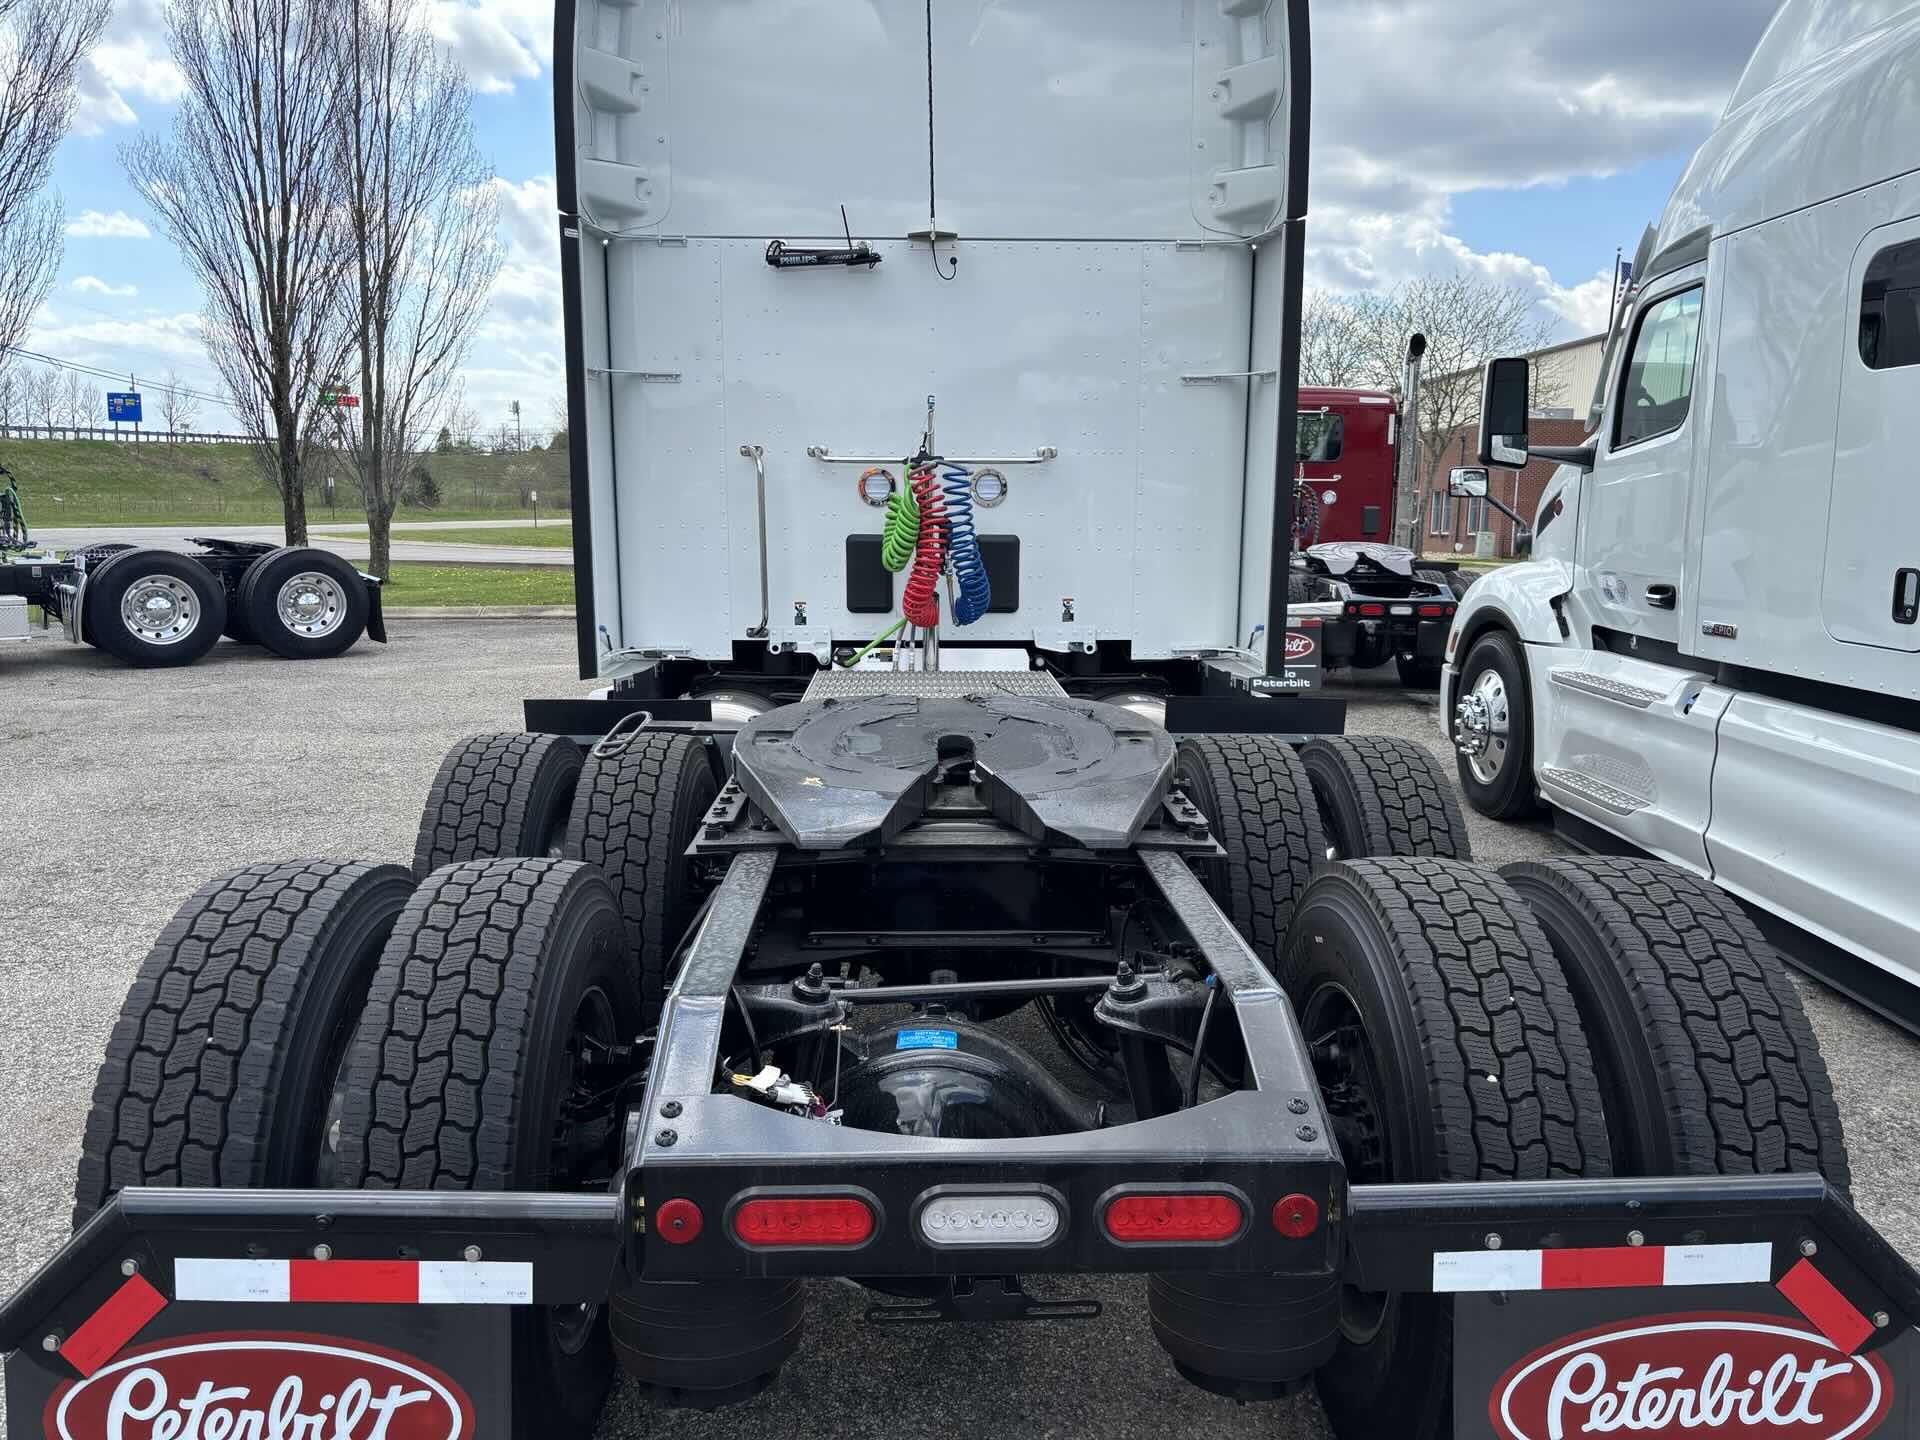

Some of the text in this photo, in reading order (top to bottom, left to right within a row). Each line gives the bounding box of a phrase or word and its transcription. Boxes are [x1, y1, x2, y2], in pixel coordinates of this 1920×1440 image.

[1253, 679, 1311, 687] Peterbilt
[106, 1367, 432, 1440] Peterbilt
[1546, 1352, 1854, 1440] Peterbilt
